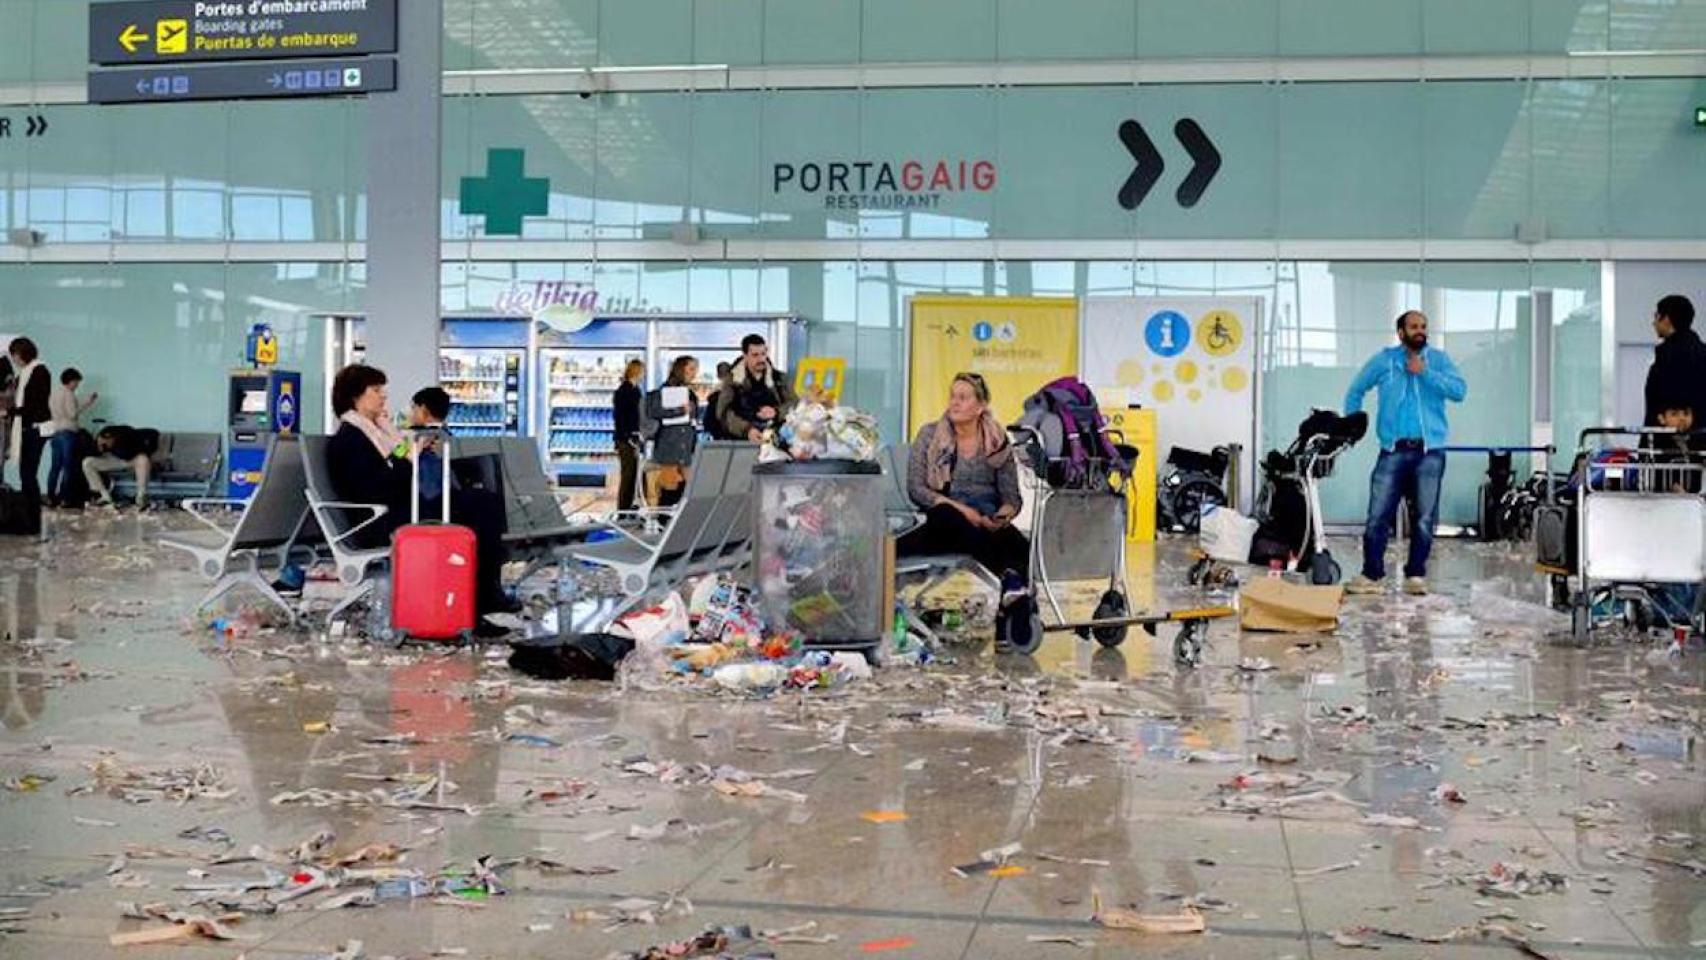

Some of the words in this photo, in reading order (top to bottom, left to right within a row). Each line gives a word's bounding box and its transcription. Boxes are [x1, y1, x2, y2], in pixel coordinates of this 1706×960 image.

[195, 2, 244, 17] Portes
[248, 0, 367, 15] d'embarcament
[195, 19, 247, 33] Boarding
[251, 19, 284, 33] gates
[195, 35, 253, 49] Puertas
[257, 33, 276, 48] de
[280, 32, 358, 47] embarque
[825, 194, 940, 210] RESTAURANT
